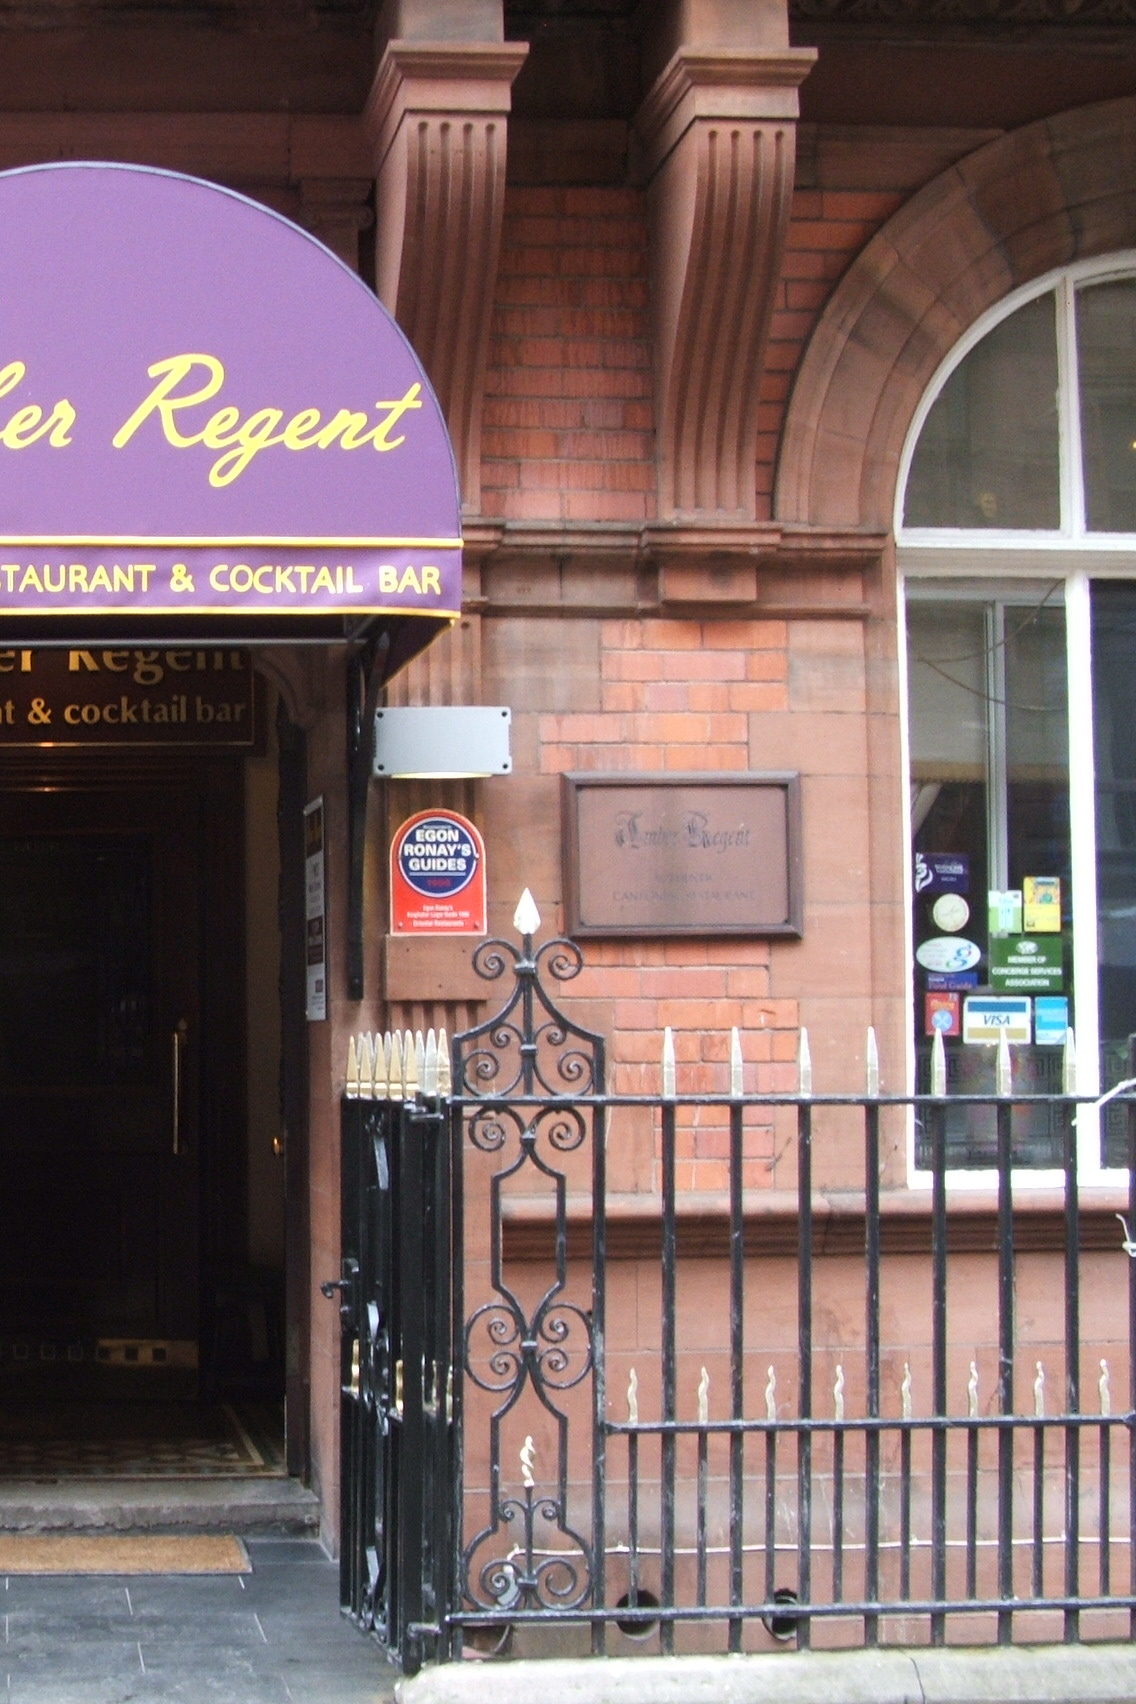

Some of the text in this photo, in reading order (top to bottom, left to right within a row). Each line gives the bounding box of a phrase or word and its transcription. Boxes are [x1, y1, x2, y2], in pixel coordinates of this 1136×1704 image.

[111, 352, 423, 488] Regent
[169, 563, 196, 593] &
[209, 564, 364, 594] COCKTAIL
[378, 564, 441, 595] BAR
[26, 697, 53, 726] &
[63, 695, 188, 725] cocktail
[195, 696, 246, 724] bar
[415, 829, 460, 843] EGON
[403, 843, 472, 857] RONAY'S
[408, 858, 467, 871] GUIDES
[982, 1014, 1011, 1026] VISA
